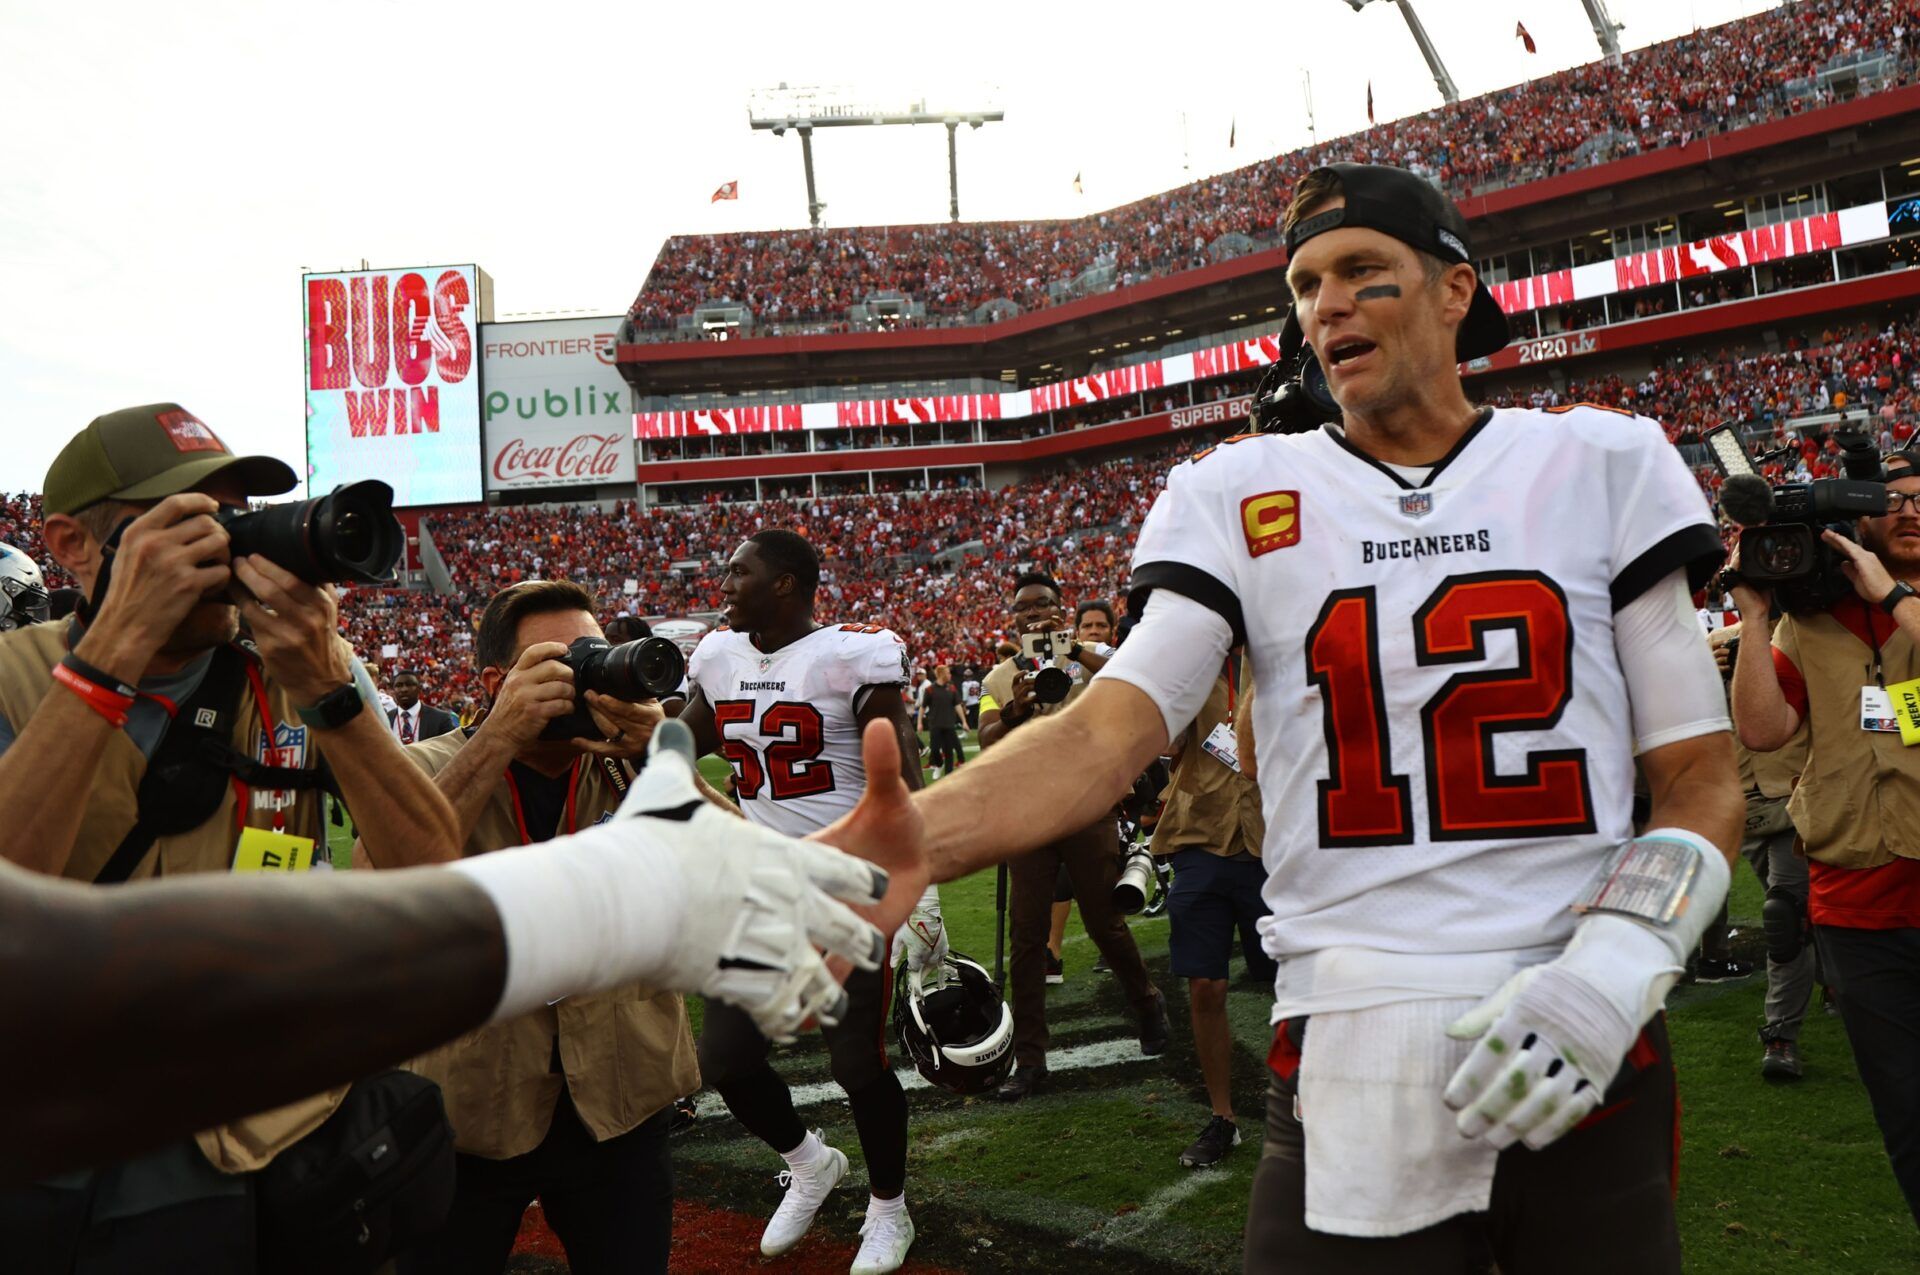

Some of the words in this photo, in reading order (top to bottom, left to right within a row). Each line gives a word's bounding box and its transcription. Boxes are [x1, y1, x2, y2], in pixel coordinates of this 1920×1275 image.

[308, 270, 472, 390] BUCS
[485, 338, 591, 359] FRONTIER
[1519, 338, 1568, 363] 2020
[344, 386, 440, 438] WIN
[1171, 405, 1225, 429] SUPER
[1229, 399, 1252, 418] BO
[1245, 493, 1295, 540] C
[1403, 500, 1429, 513] NFL
[1362, 530, 1491, 564] BUCCANEERS
[740, 681, 786, 691] BUCCANEERS
[1305, 570, 1597, 849] 12
[714, 699, 836, 800] 52
[604, 757, 626, 791] Canon
[254, 789, 296, 809] MEDI
[262, 850, 282, 867] 17
[975, 1049, 997, 1063] HATE
